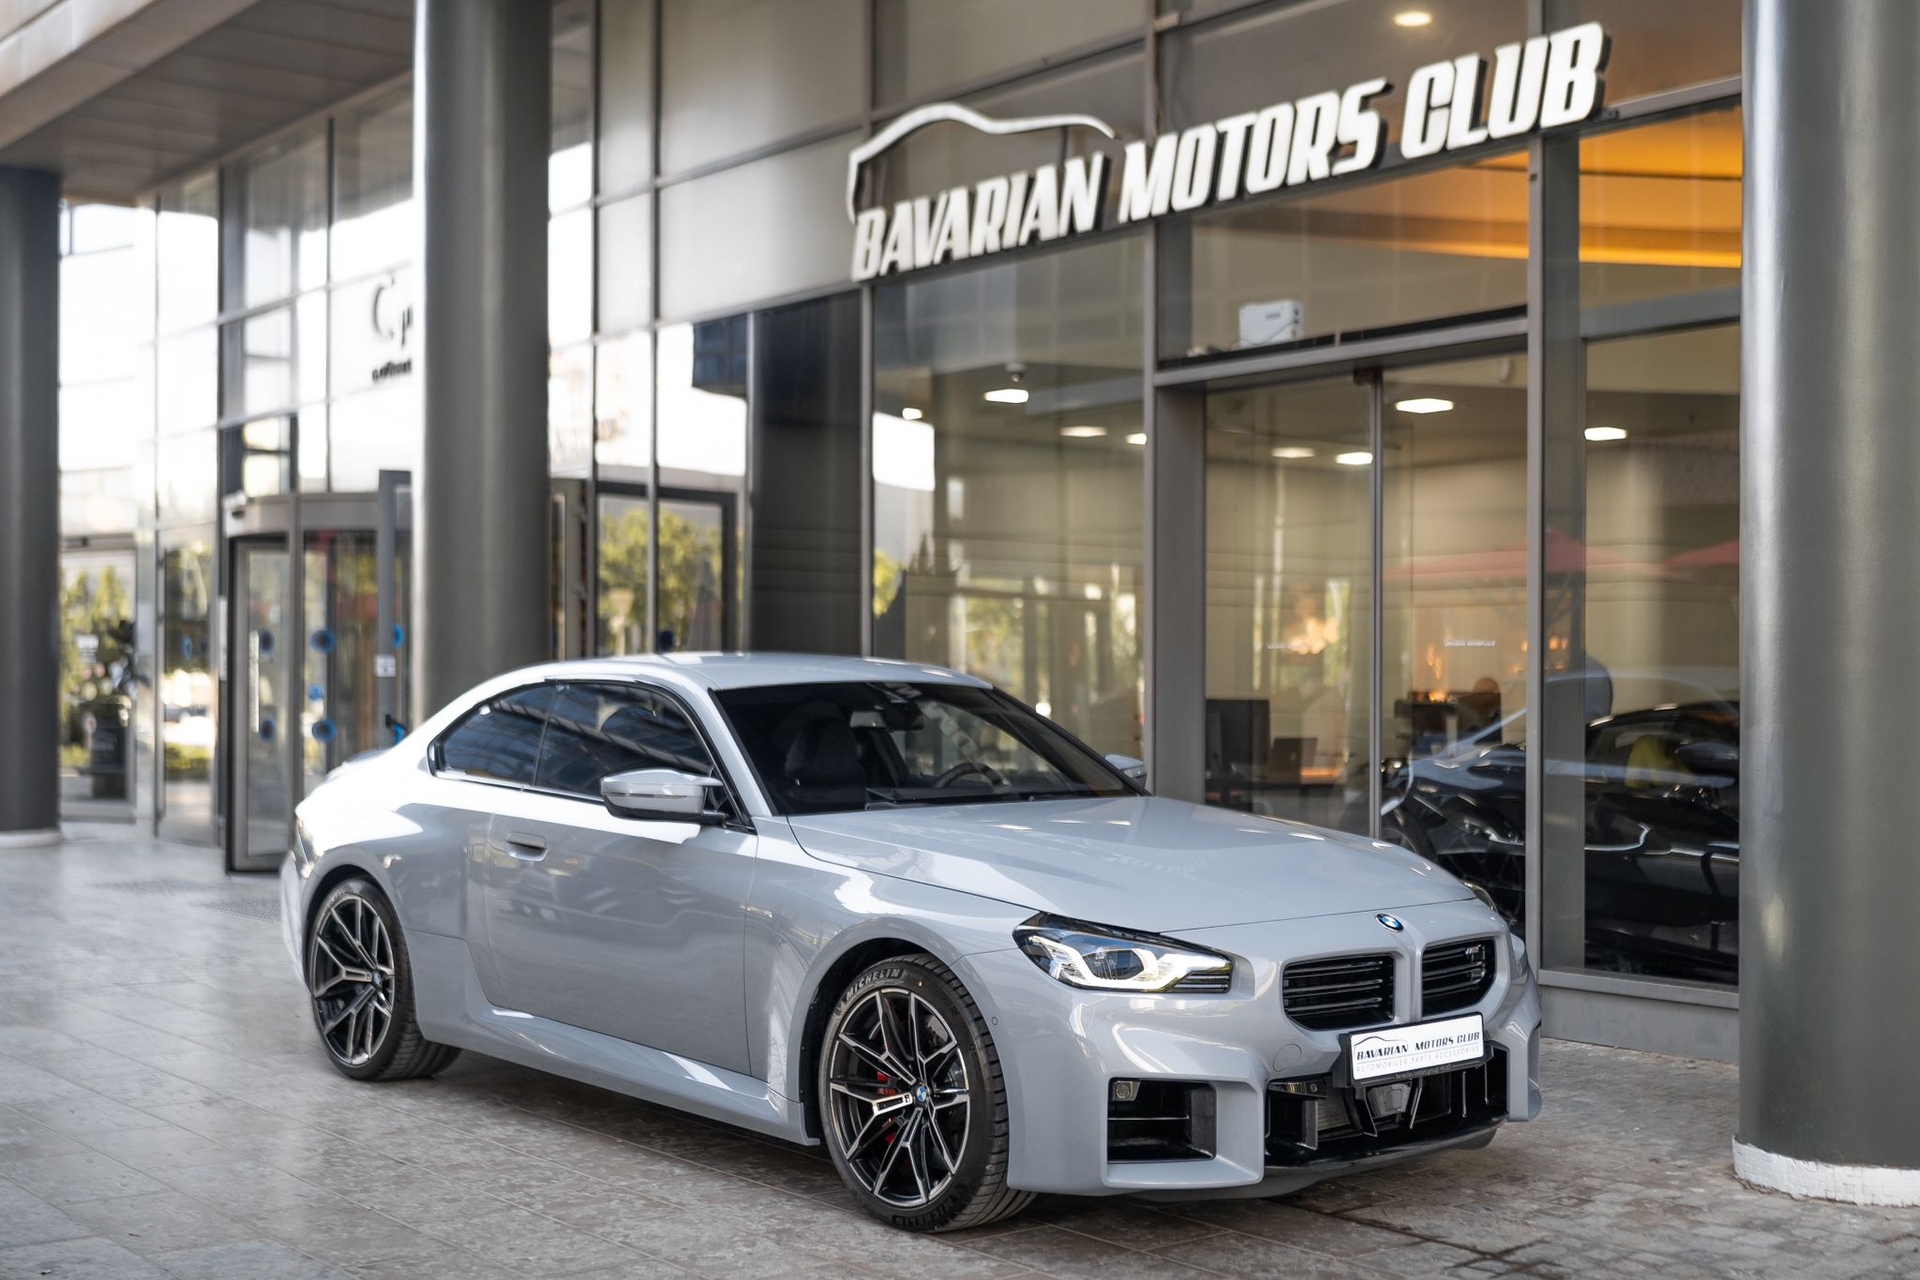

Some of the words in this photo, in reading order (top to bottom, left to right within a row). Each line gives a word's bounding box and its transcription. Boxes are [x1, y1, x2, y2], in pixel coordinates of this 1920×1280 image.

[851, 151, 1108, 282] BAVARIAN
[1118, 77, 1393, 224] MOTORS
[1400, 21, 1608, 159] CLUB
[845, 967, 901, 1001] MICHELIN
[1356, 1044, 1409, 1061] BAVARIAN
[1414, 1036, 1454, 1051] MOTORS
[1456, 1031, 1480, 1044] CLUB
[1356, 1058, 1407, 1072] AUTOMOBILES
[1411, 1053, 1431, 1064] PARTS
[1435, 1045, 1480, 1059] ACCESSORIES
